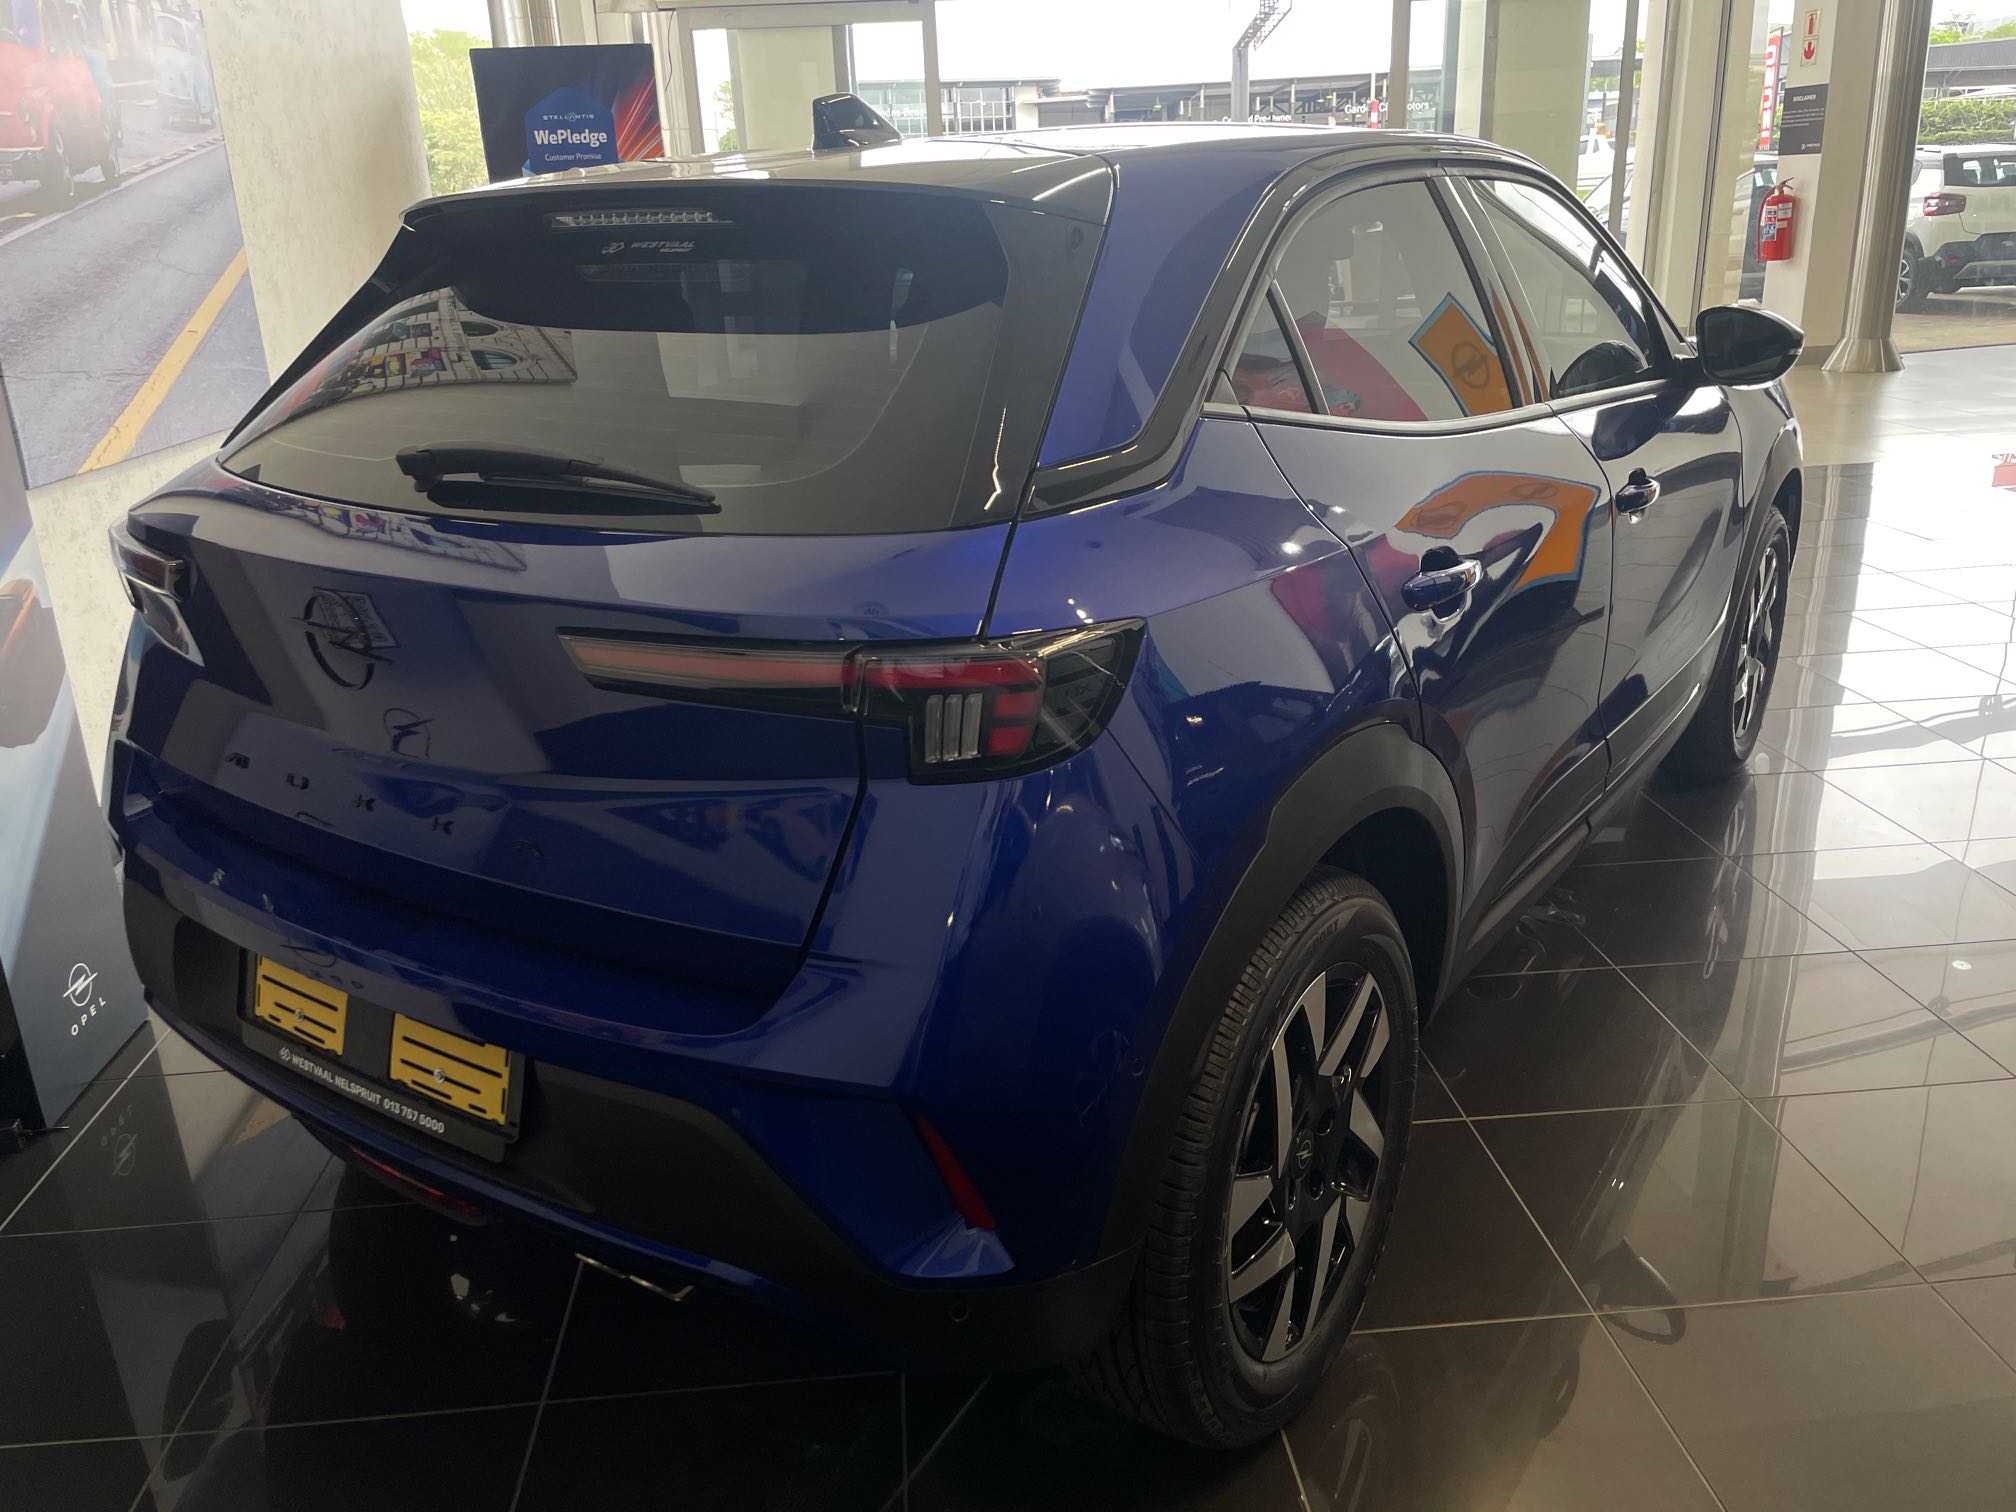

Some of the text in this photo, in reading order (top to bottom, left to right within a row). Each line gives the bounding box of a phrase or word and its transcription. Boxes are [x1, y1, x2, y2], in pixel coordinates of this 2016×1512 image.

[1407, 102, 1429, 111] otors
[542, 113, 595, 122] STELLANTIS
[534, 128, 608, 147] WePledge
[544, 152, 602, 162] Customer Promise
[631, 240, 696, 249] WESTVAAL
[71, 997, 106, 1036] OPEL
[291, 1053, 334, 1083] WESTVAAL
[334, 1076, 382, 1105] NELSPRUIT
[384, 1098, 401, 1114] 013
